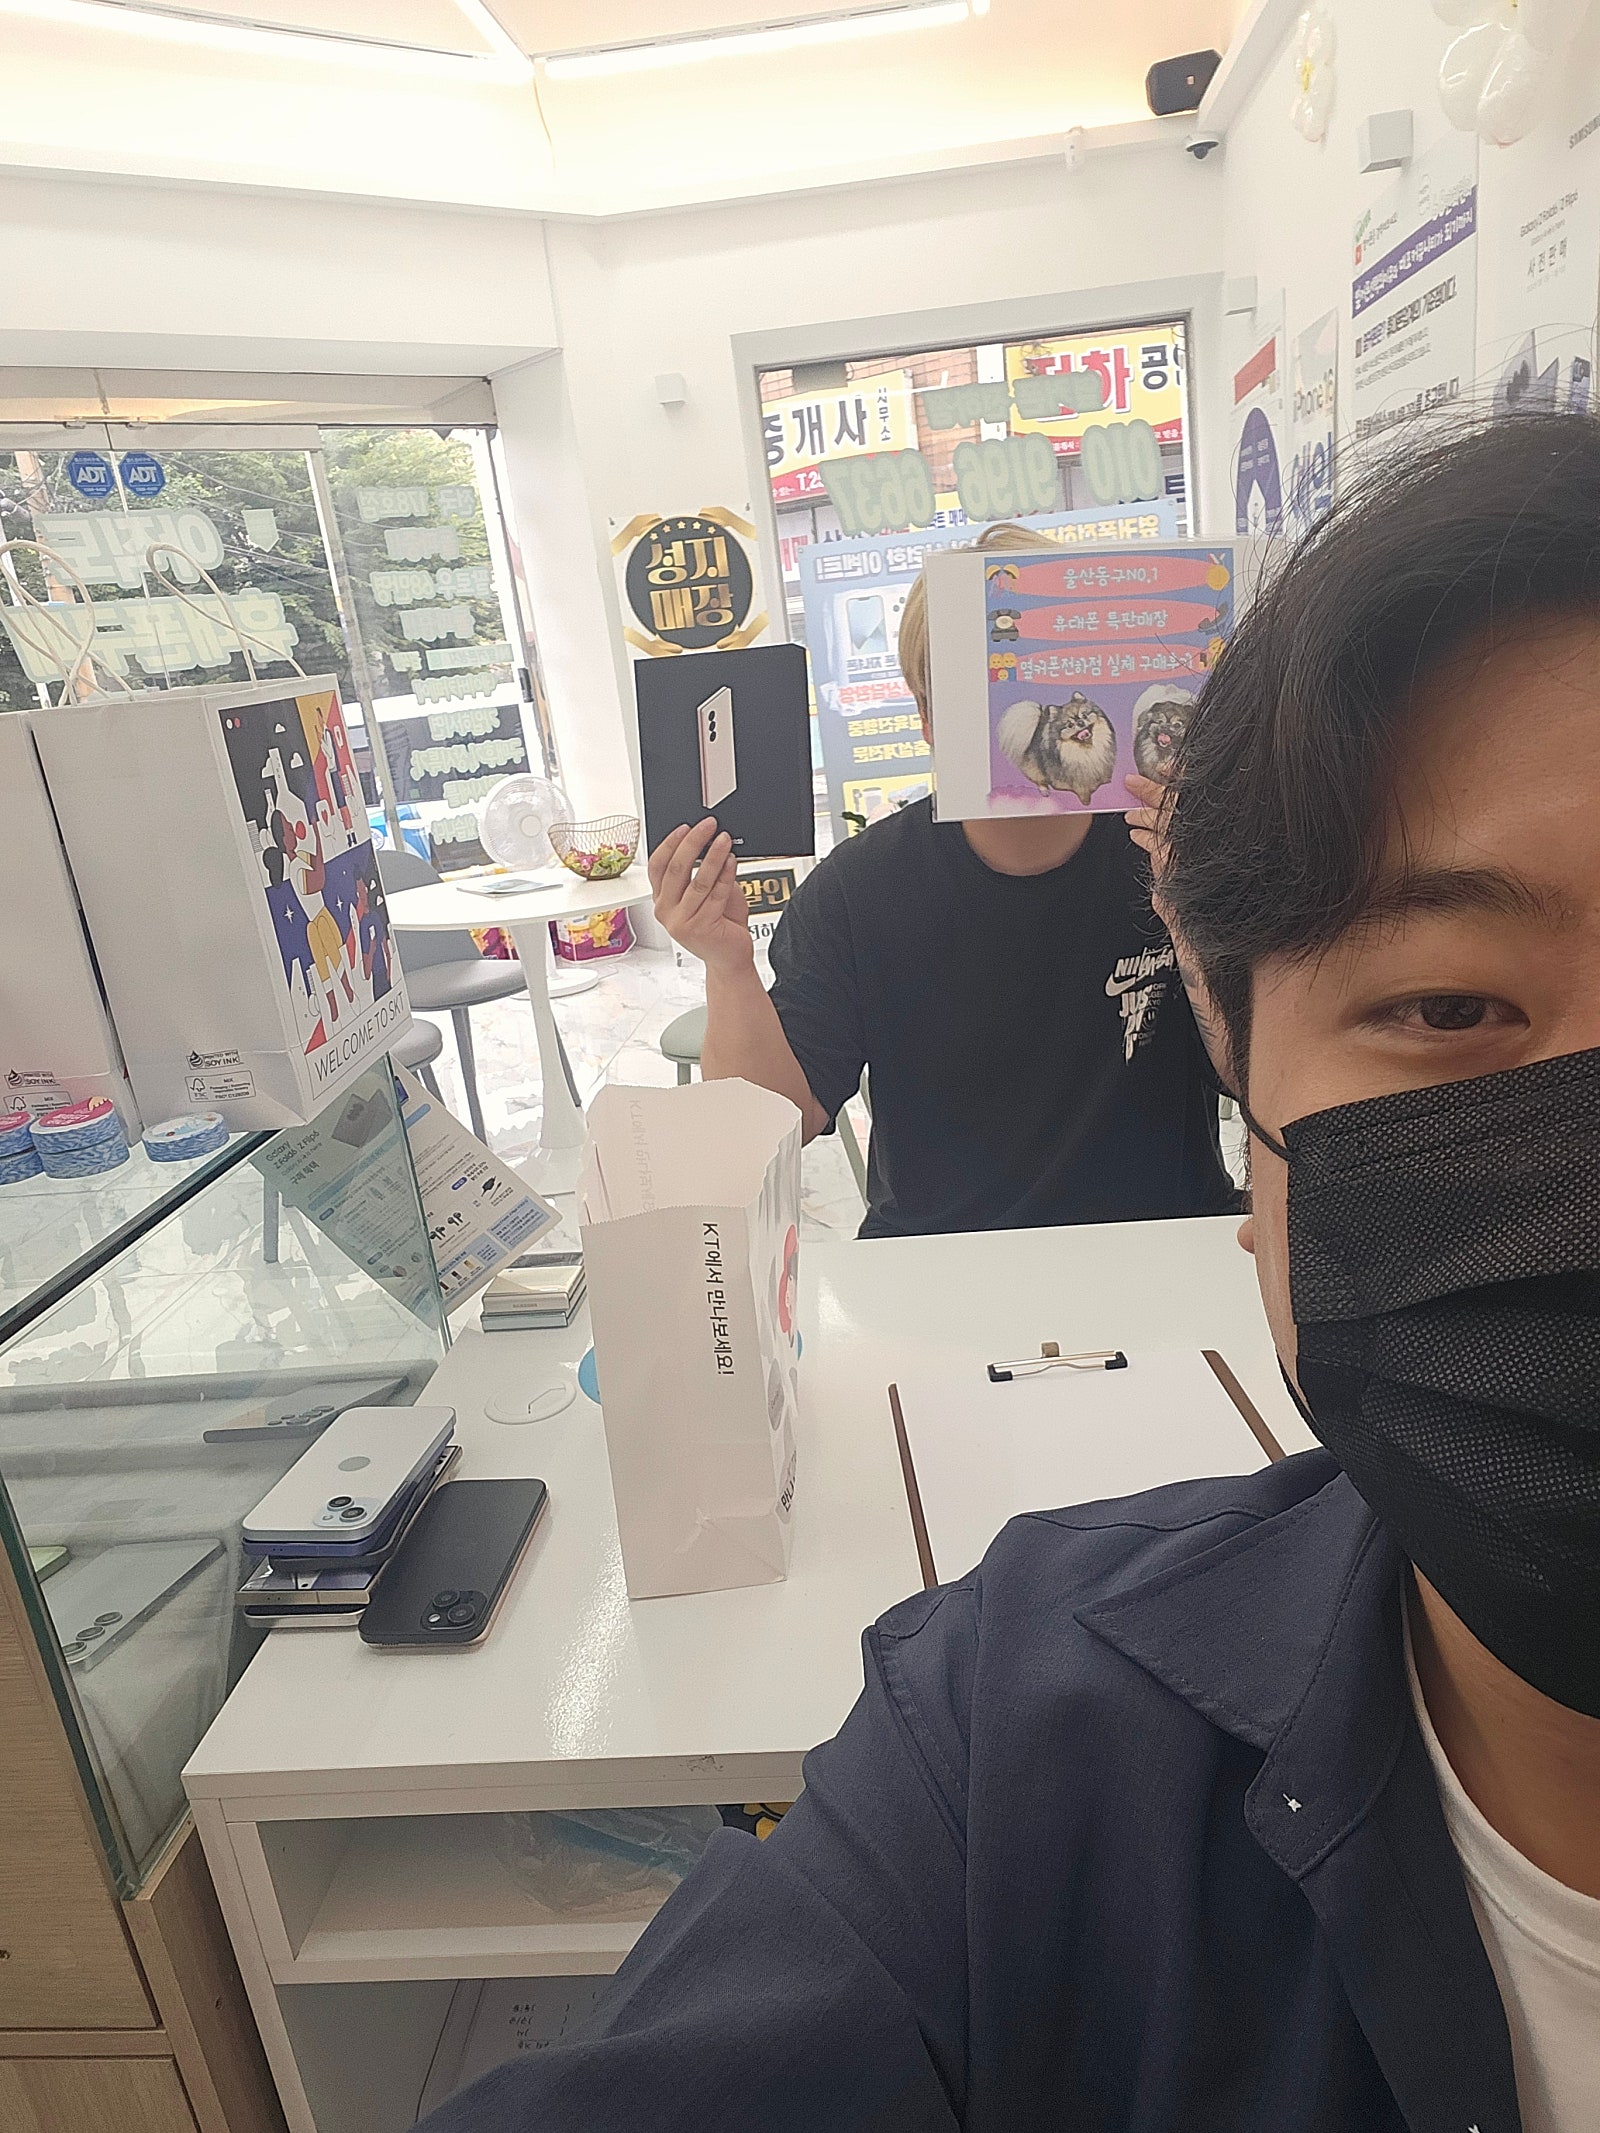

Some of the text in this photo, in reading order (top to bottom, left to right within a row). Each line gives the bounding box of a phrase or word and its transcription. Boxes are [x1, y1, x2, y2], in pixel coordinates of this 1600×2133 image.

[77, 466, 106, 483] ADT
[129, 466, 157, 483] ADT
[645, 536, 731, 585] 성지
[1063, 566, 1158, 589] 울산동구NO.1
[650, 584, 734, 631] 매장
[1053, 609, 1169, 632] 휴대폰 특판매장
[1107, 653, 1136, 677] 실제
[314, 991, 404, 1082] WELCOME TO SKT
[223, 1057, 238, 1065] INK
[702, 1222, 735, 1376] KT에서 만나보세요!
